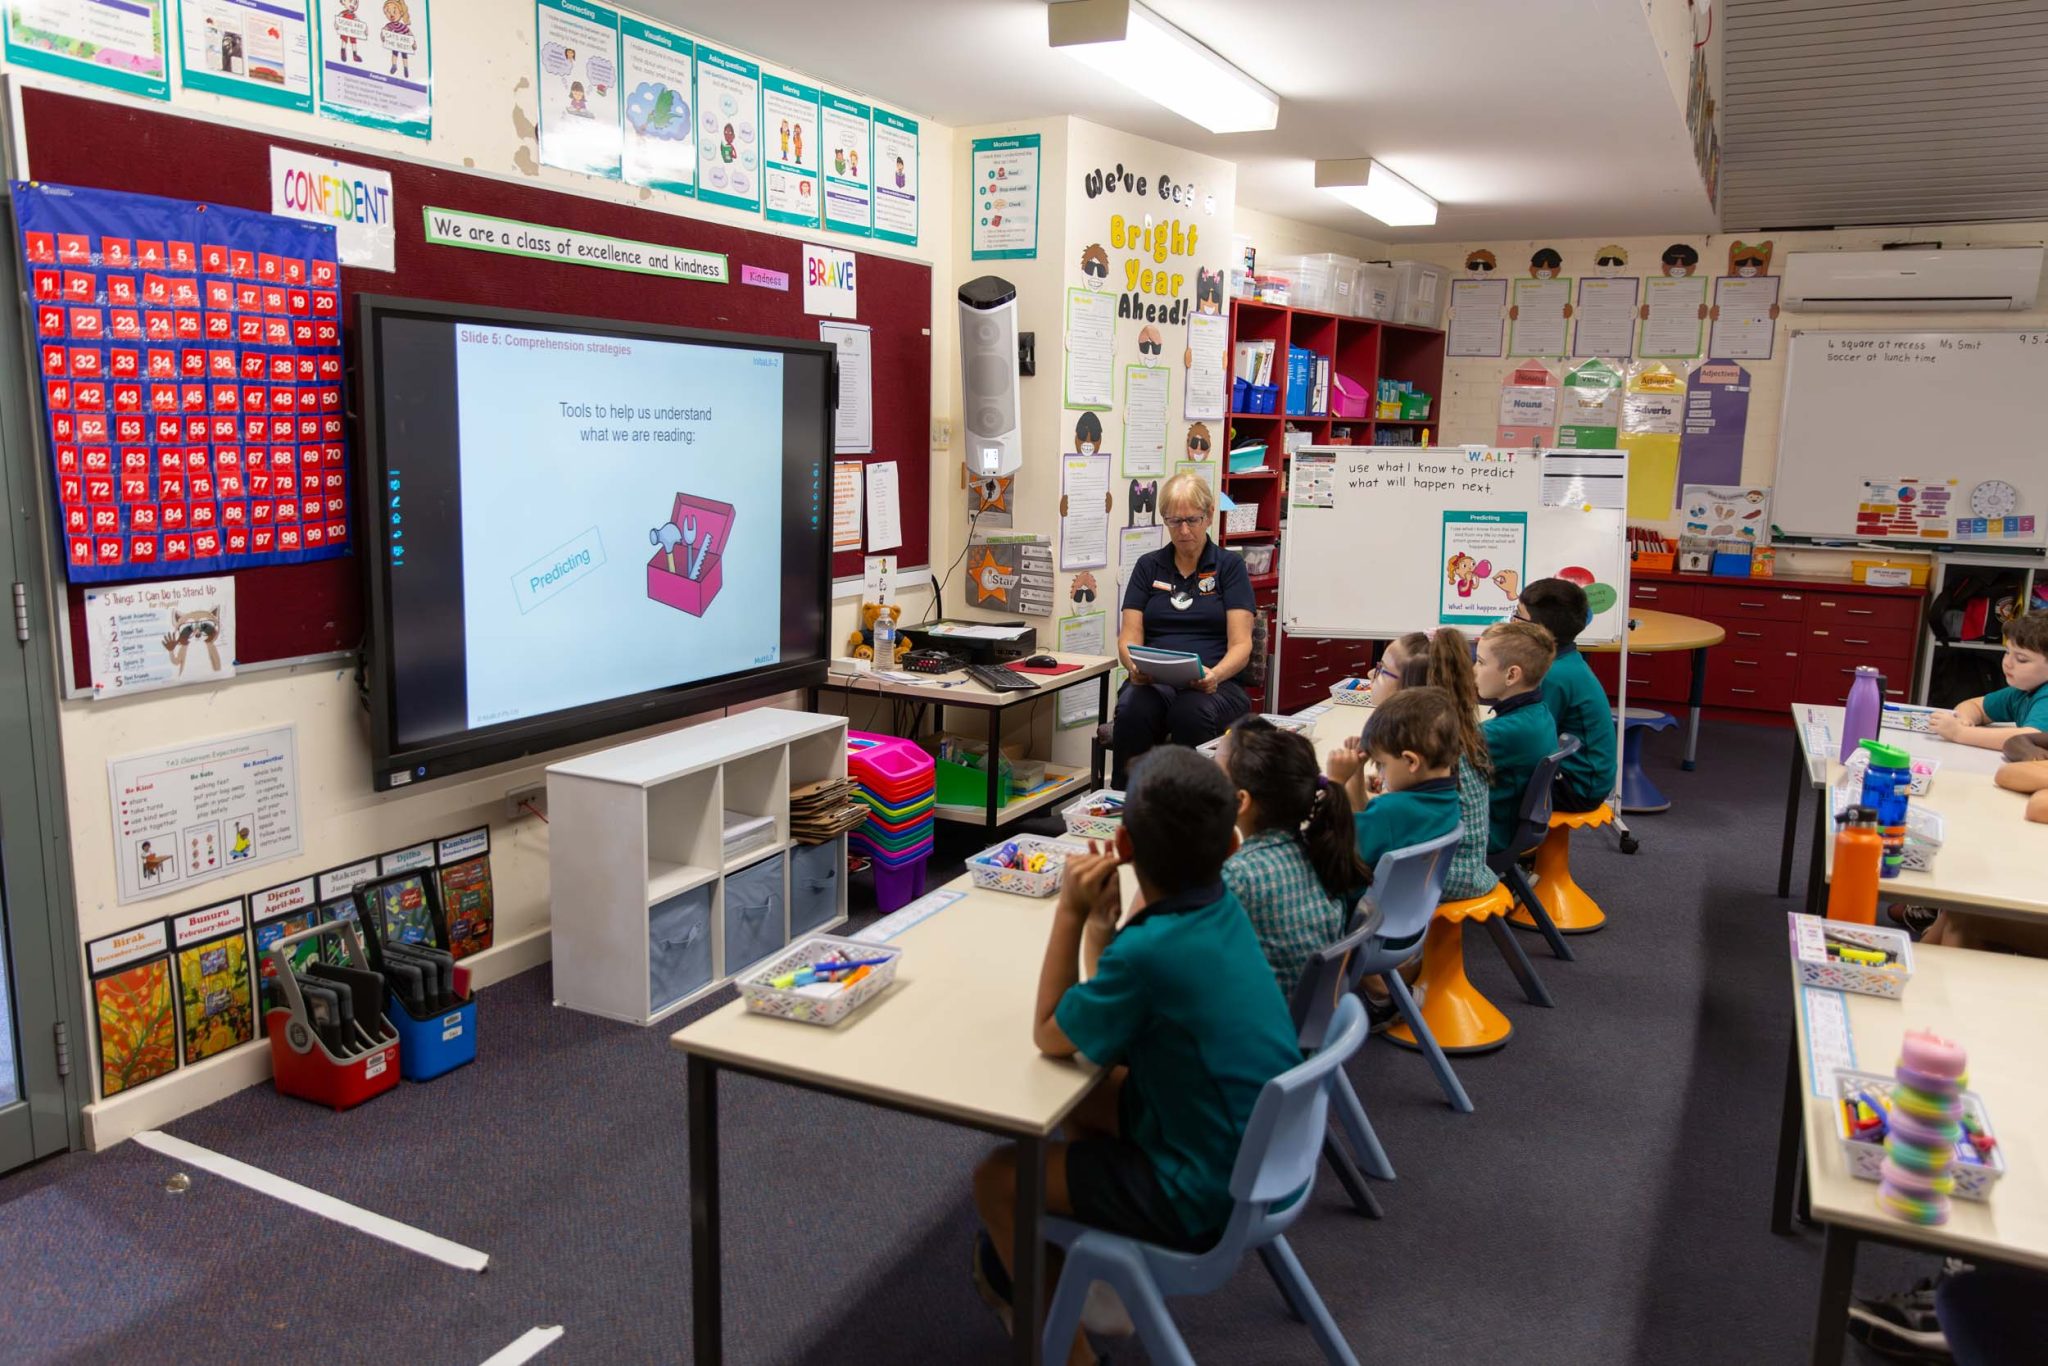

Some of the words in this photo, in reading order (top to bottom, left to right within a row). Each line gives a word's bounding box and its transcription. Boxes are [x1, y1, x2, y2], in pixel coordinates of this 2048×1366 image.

[562, 0, 596, 19] Connecting
[708, 54, 724, 67] Asking
[724, 60, 747, 72] questions
[992, 139, 1019, 148] Monitoring
[1085, 162, 1147, 198] We've
[284, 169, 390, 225] CONFIDENT
[434, 216, 462, 238] We
[469, 228, 494, 243] are
[501, 233, 510, 245] a
[517, 232, 550, 253] class
[556, 239, 572, 255] of
[578, 244, 641, 264] excellence
[648, 253, 668, 269] and
[674, 257, 720, 277] kindness
[1110, 214, 1198, 264] Bright
[36, 240, 44, 254] 1
[68, 242, 80, 253] 2
[112, 245, 122, 258] 3
[146, 248, 156, 261] 4
[178, 249, 187, 264] 5
[210, 253, 219, 265] 6
[238, 258, 246, 271] 7
[266, 262, 274, 273] 8
[290, 265, 298, 277] 9
[318, 268, 330, 279] 10
[749, 271, 781, 287] Kindness
[808, 257, 854, 290] BRAVE
[1125, 258, 1184, 297] Year
[42, 278, 52, 291] 11
[72, 279, 87, 293] 12
[115, 284, 130, 298] 13
[150, 282, 164, 296] 14
[178, 286, 192, 297] 15
[213, 288, 227, 301] 16
[242, 292, 255, 304] 17
[268, 294, 280, 306] 18
[293, 296, 304, 308] 19
[317, 297, 332, 308] 20
[1118, 293, 1189, 326] Ahead!
[46, 313, 58, 327] 21
[76, 316, 96, 329] 22
[116, 317, 134, 330] 23
[151, 318, 168, 332] 24
[180, 318, 196, 330] 25
[211, 318, 227, 331] 26
[243, 322, 259, 334] 27
[270, 324, 286, 337] 28
[298, 327, 311, 338] 29
[320, 327, 335, 338] 30
[460, 331, 490, 344] Slide
[493, 332, 502, 345] 5:
[505, 334, 584, 353] Comprehension
[587, 340, 632, 356] strategies
[1842, 340, 1874, 350] square
[1878, 340, 1891, 349] at
[50, 352, 61, 366] 31
[76, 355, 95, 368] 32
[116, 356, 134, 369] 33
[154, 356, 170, 370] 34
[186, 356, 202, 368] 35
[215, 356, 232, 369] 36
[246, 358, 262, 370] 37
[275, 361, 291, 373] 38
[300, 361, 313, 372] 39
[322, 361, 338, 372] 40
[1884, 354, 1910, 362] lunch
[1915, 355, 1936, 364] time
[1702, 370, 1738, 378] Adjectives
[559, 402, 592, 419] Tools
[595, 404, 606, 419] to
[610, 404, 634, 422] help
[638, 409, 651, 420] us
[654, 406, 712, 421] understand
[1514, 400, 1542, 408] Nouns
[1634, 406, 1672, 415] Adverbs
[580, 427, 608, 442] what
[612, 431, 629, 442] we
[632, 431, 650, 442] are
[653, 428, 696, 445] reading:
[1349, 464, 1369, 473] use
[1377, 461, 1403, 473] what
[1418, 464, 1446, 474] know
[1451, 465, 1464, 475] to
[1471, 465, 1515, 479] predict
[1349, 479, 1379, 489] what
[1387, 477, 1406, 488] will
[1414, 478, 1455, 491] happen
[530, 548, 590, 593] Predicting
[113, 592, 135, 605] Things
[138, 592, 143, 602] I
[146, 591, 159, 600] Can
[161, 590, 170, 600] Do
[172, 590, 181, 599] to
[183, 587, 203, 598] Stand
[206, 585, 217, 597] Up
[1477, 603, 1497, 613] happen
[110, 616, 116, 627] 1
[112, 632, 118, 642] 2
[112, 648, 119, 657] 3
[114, 662, 120, 672] 4
[116, 676, 122, 687] 5
[136, 784, 153, 792] Kind
[442, 832, 485, 850] Kambarang
[331, 867, 366, 882] Makuru
[267, 886, 301, 902] Djeran
[264, 895, 305, 914] April-May
[189, 908, 230, 926] Bunuru
[179, 916, 241, 940] February-March
[112, 933, 145, 948] Birak
